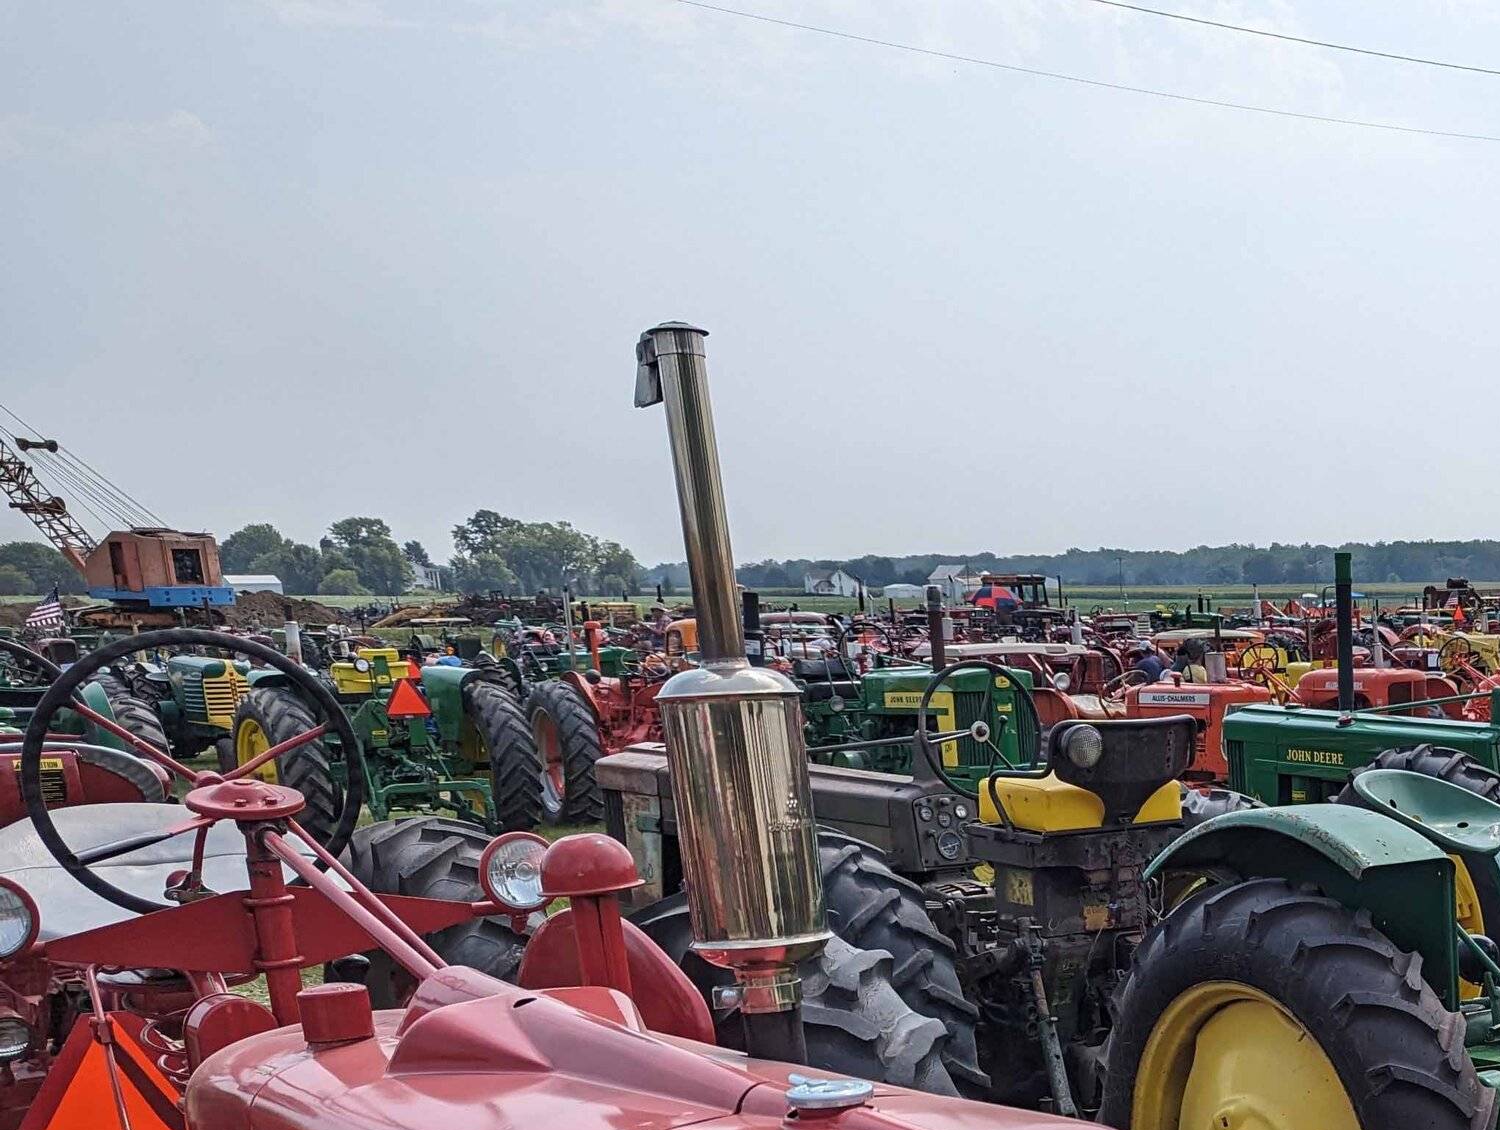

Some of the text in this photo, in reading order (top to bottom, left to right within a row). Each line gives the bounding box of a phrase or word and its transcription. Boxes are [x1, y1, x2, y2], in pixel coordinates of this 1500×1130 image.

[1151, 695, 1196, 703] ALLIS-CHALMERS
[1286, 749, 1345, 766] JOHN DEERE
